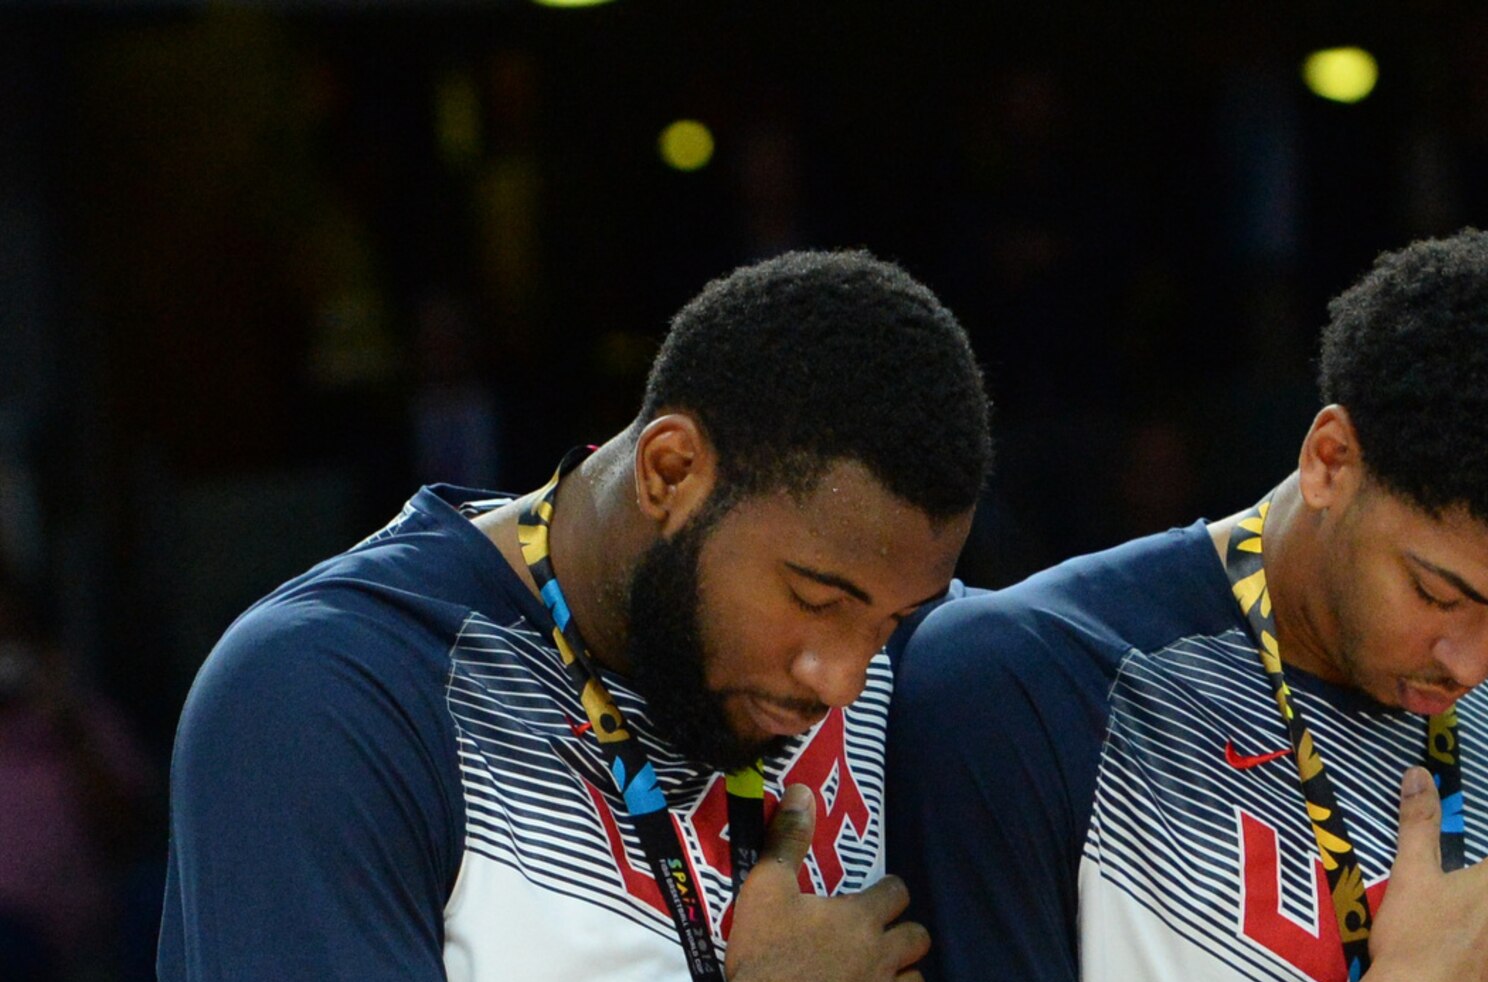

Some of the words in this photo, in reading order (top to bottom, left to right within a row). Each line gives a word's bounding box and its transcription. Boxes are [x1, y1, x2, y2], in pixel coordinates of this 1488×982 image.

[666, 878, 689, 926] BASKETBALL
[686, 928, 699, 957] WORLD
[693, 927, 714, 973] 2014
